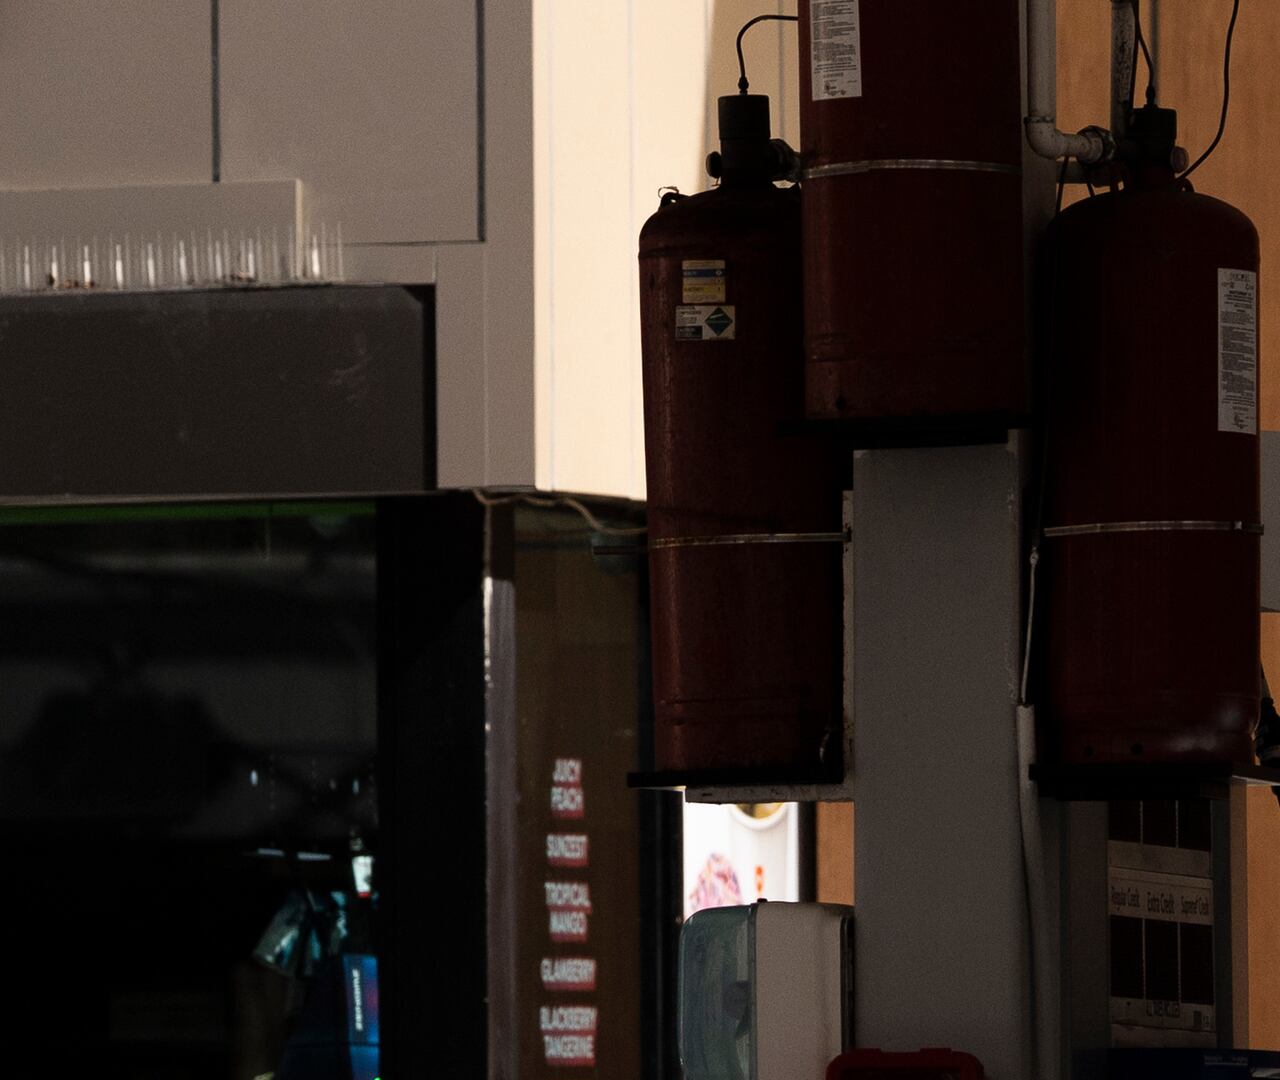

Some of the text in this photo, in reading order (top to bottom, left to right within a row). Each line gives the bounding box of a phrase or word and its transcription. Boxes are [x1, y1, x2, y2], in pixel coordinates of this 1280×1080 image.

[552, 758, 582, 783] JUICY
[551, 786, 584, 811] PEACH
[544, 881, 591, 906] TROPICAL
[550, 911, 587, 935] MANGO
